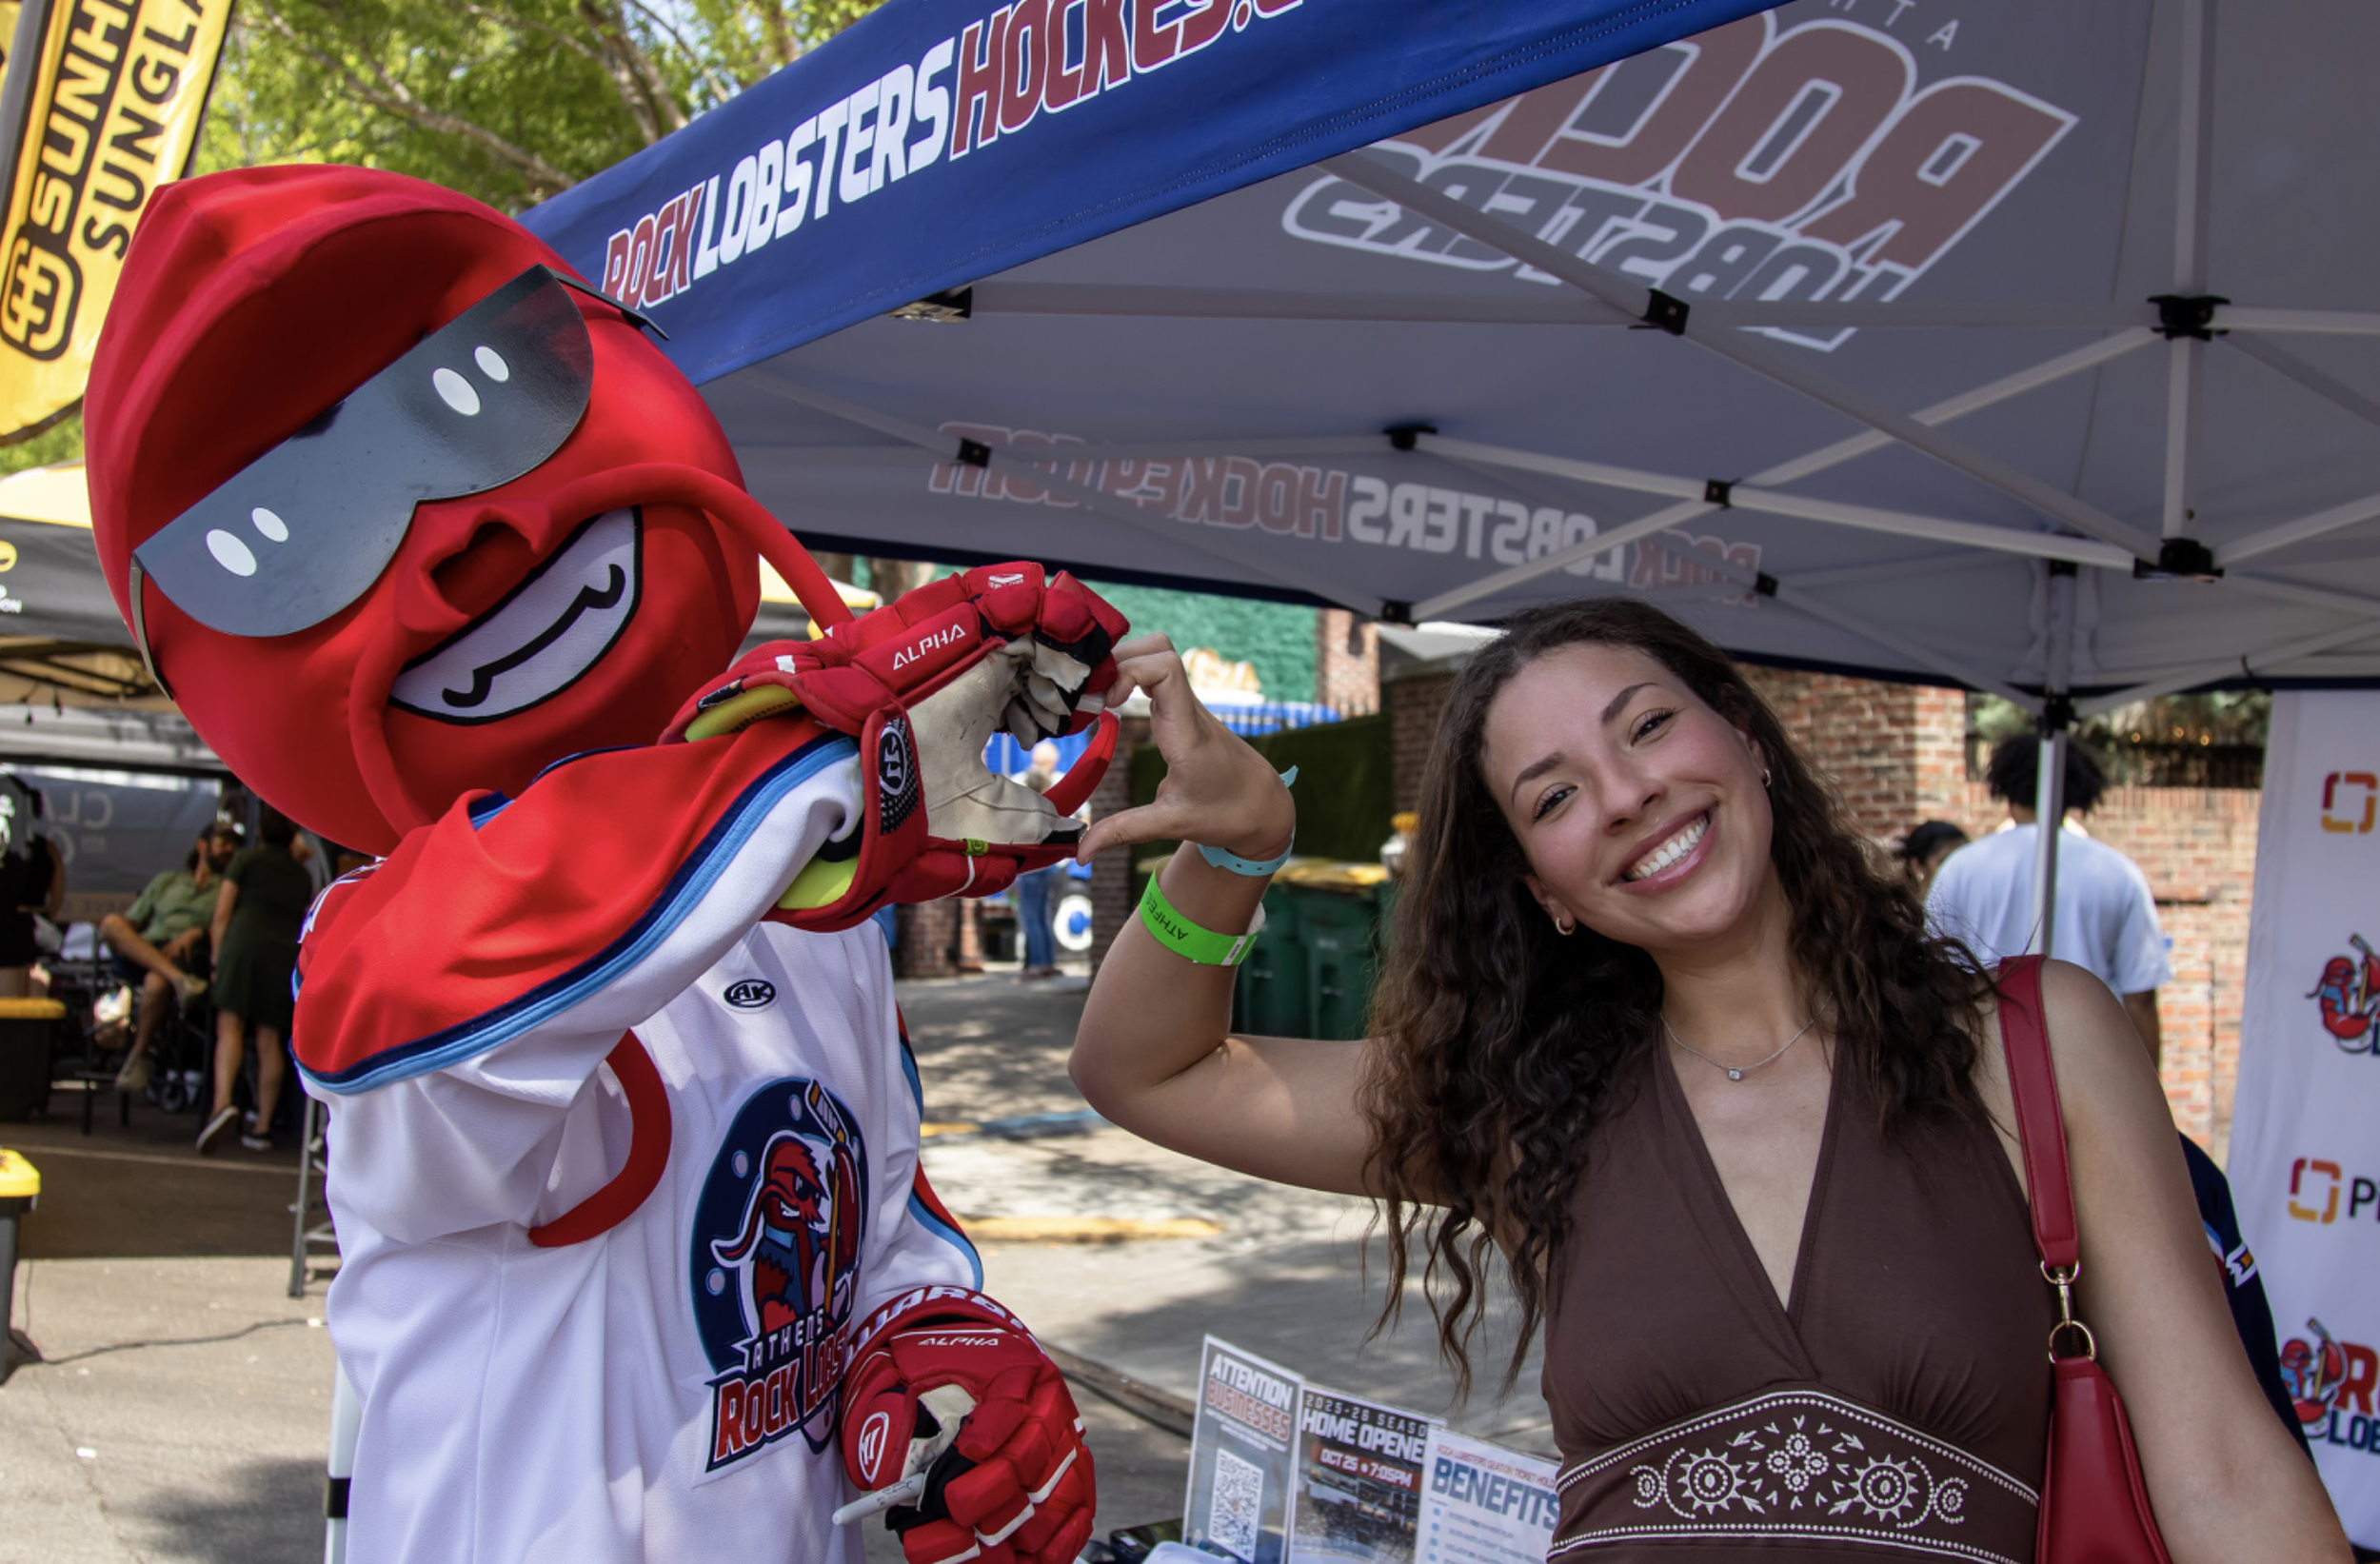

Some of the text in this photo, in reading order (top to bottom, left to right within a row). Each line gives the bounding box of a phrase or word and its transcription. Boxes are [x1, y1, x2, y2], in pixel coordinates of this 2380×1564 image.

[30, 0, 135, 235] SUNH
[893, 624, 966, 671] ALPHA
[752, 1308, 824, 1370] ATHENS
[917, 1336, 999, 1346] ALPHA
[713, 1357, 801, 1463] ROCK
[1206, 1378, 1292, 1442] BUSINESSES
[1209, 1353, 1293, 1411] ATTENTION
[1300, 1408, 1359, 1446] HOME
[1358, 1423, 1426, 1465] OPENE
[1377, 1413, 1427, 1437] SEASO
[1320, 1449, 1413, 1488] OCT 25 7:05PM
[1431, 1456, 1560, 1531] BENEFITS
